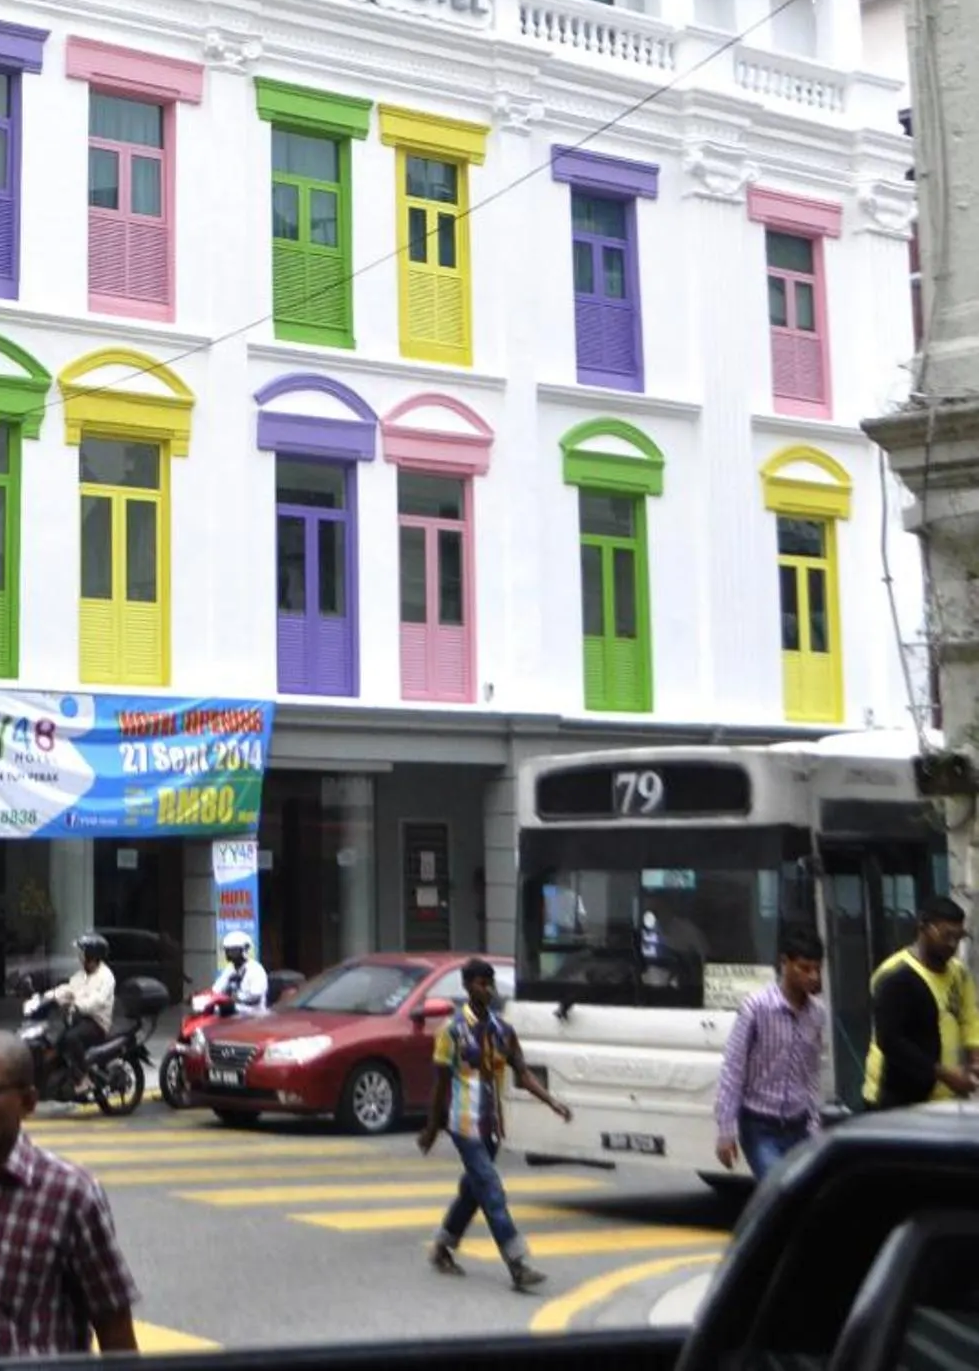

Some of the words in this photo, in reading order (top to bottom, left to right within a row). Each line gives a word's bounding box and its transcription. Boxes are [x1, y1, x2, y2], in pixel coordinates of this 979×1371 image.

[151, 741, 210, 777] Sept
[213, 739, 262, 770] 2014
[157, 785, 235, 825] RM80
[616, 770, 664, 816] 79
